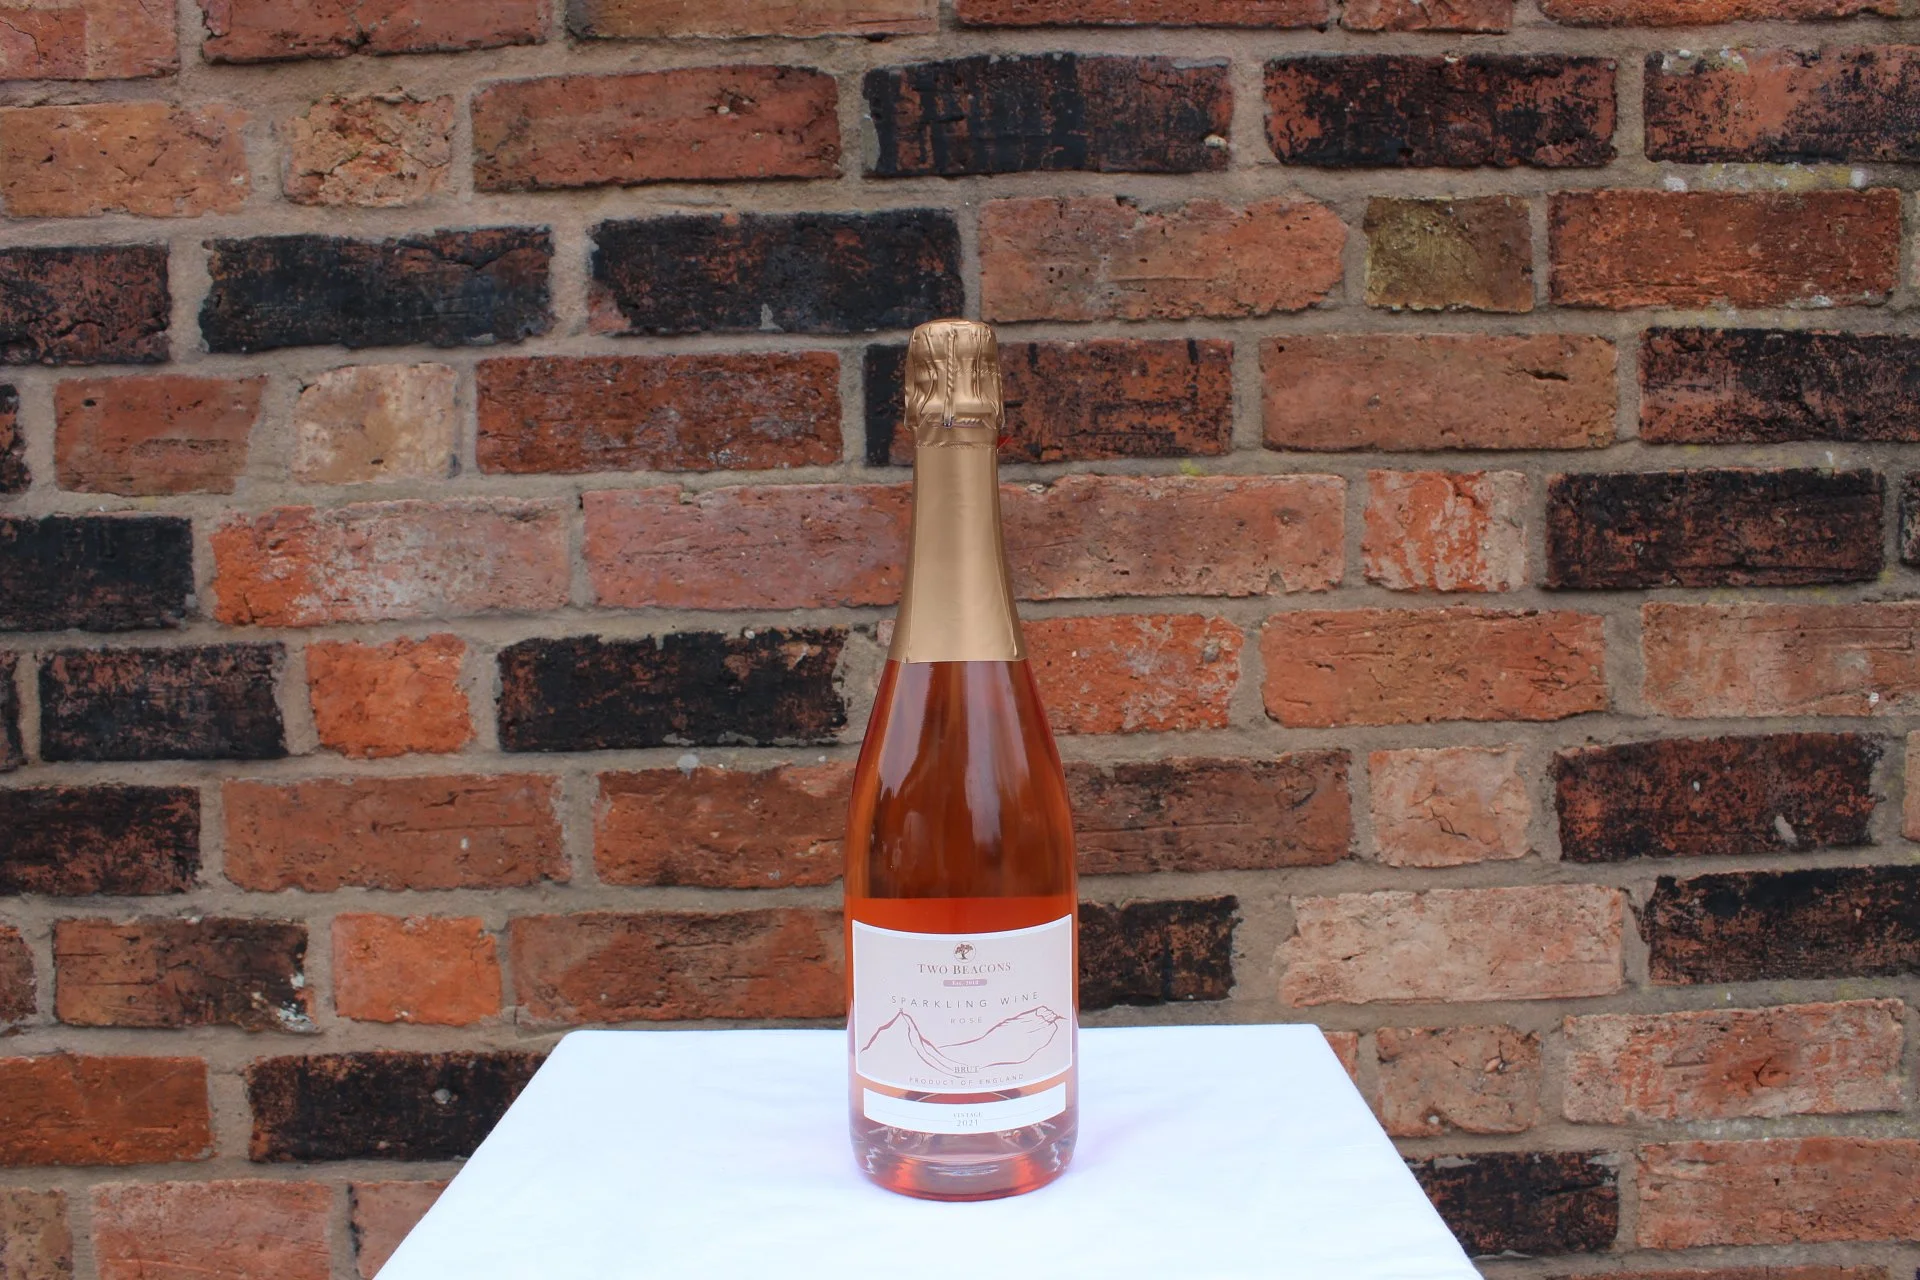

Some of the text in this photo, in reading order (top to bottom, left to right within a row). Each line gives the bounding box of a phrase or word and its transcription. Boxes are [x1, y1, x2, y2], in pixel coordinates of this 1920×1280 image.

[918, 962, 1011, 974] TWO BEACONS
[891, 991, 1040, 1009] SPARKLING WINE
[954, 1065, 979, 1074] BRUT
[909, 1076, 954, 1086] PRODUCT
[979, 1073, 1024, 1085] ENGLAND
[956, 1119, 979, 1127] 2021
